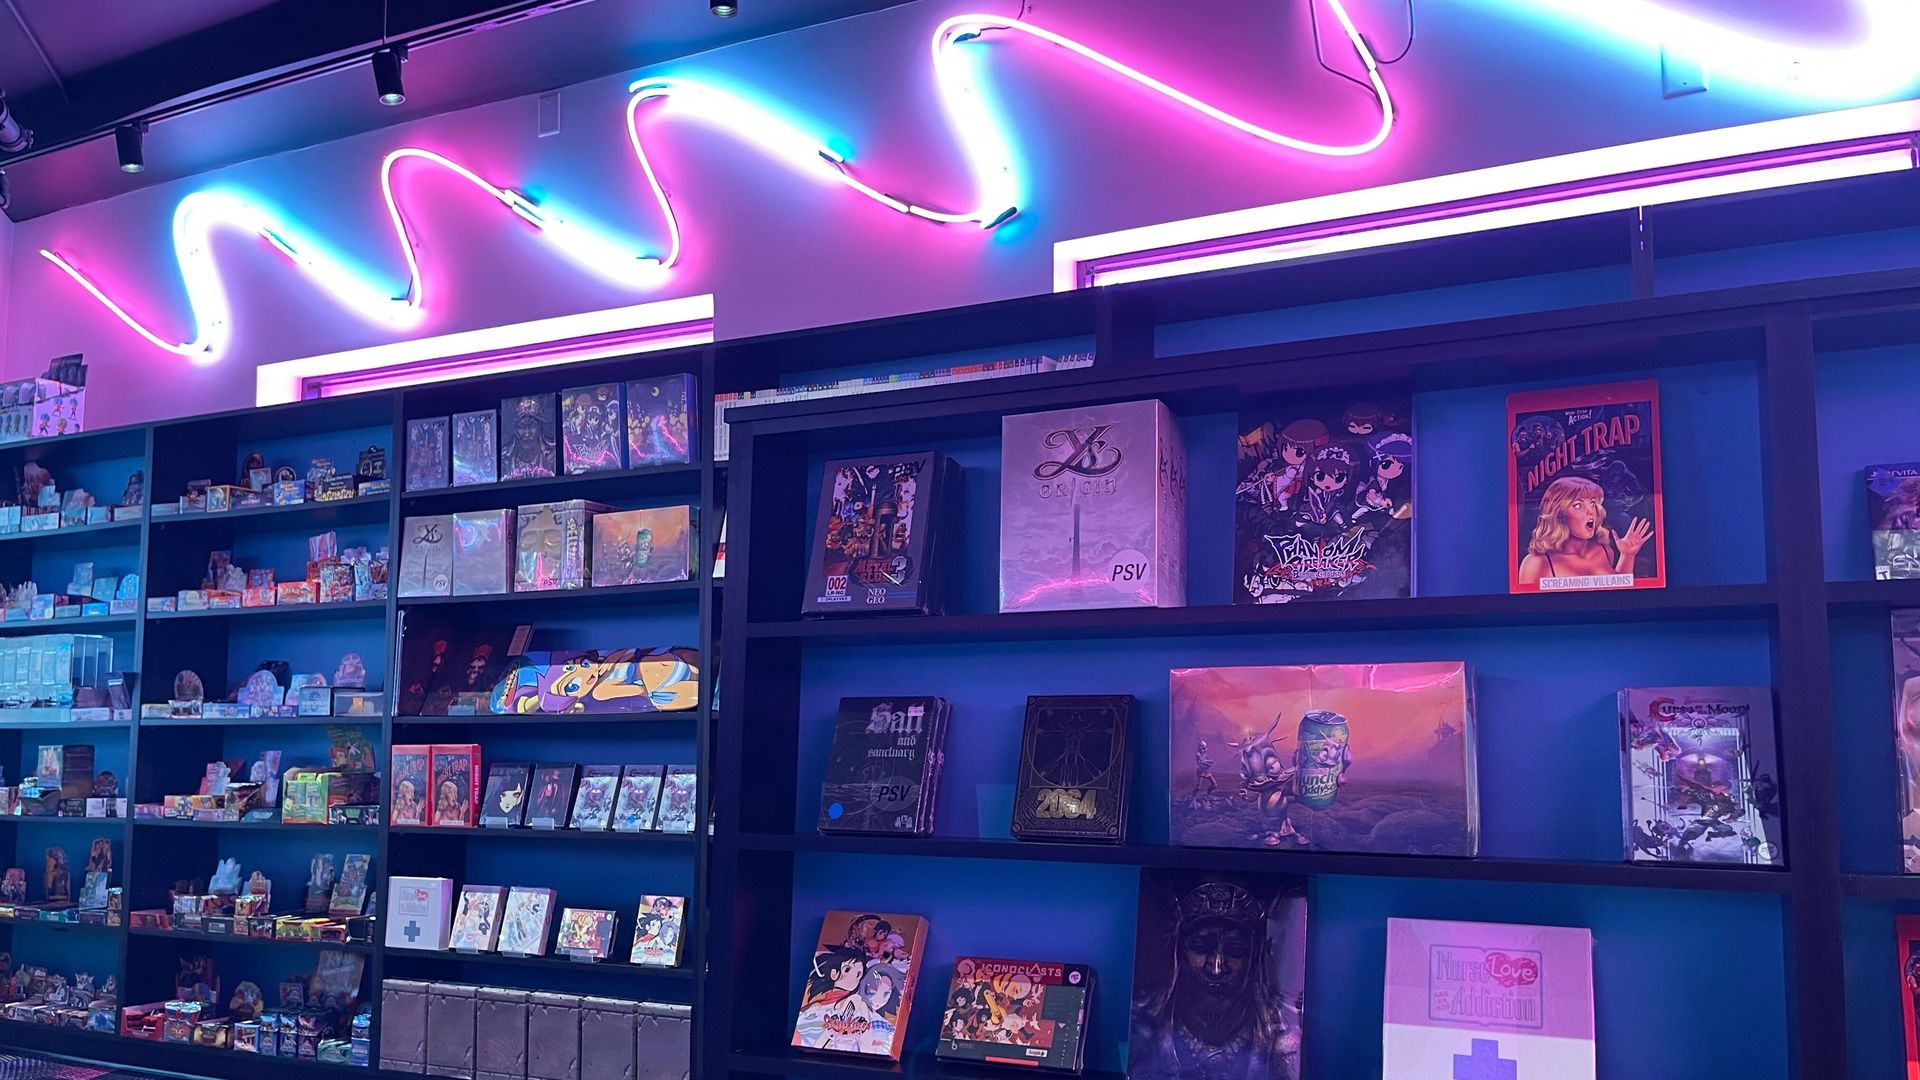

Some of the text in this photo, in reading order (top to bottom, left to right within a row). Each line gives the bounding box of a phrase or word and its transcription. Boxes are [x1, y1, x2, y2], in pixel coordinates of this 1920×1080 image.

[1527, 414, 1640, 493] NIGHT TRAP
[1112, 563, 1148, 582] PSV
[828, 577, 847, 591] 002
[1542, 575, 1632, 588] SCREAMING VILLAINS
[868, 587, 886, 596] NEO
[866, 596, 885, 604] GEO
[897, 736, 916, 746] and
[867, 747, 915, 761] sanctuary
[877, 784, 912, 801] PSV
[982, 962, 1063, 977] ICONOCLASTS
[1436, 951, 1537, 983] Nurse Love
[1450, 985, 1538, 1022] Addiction
